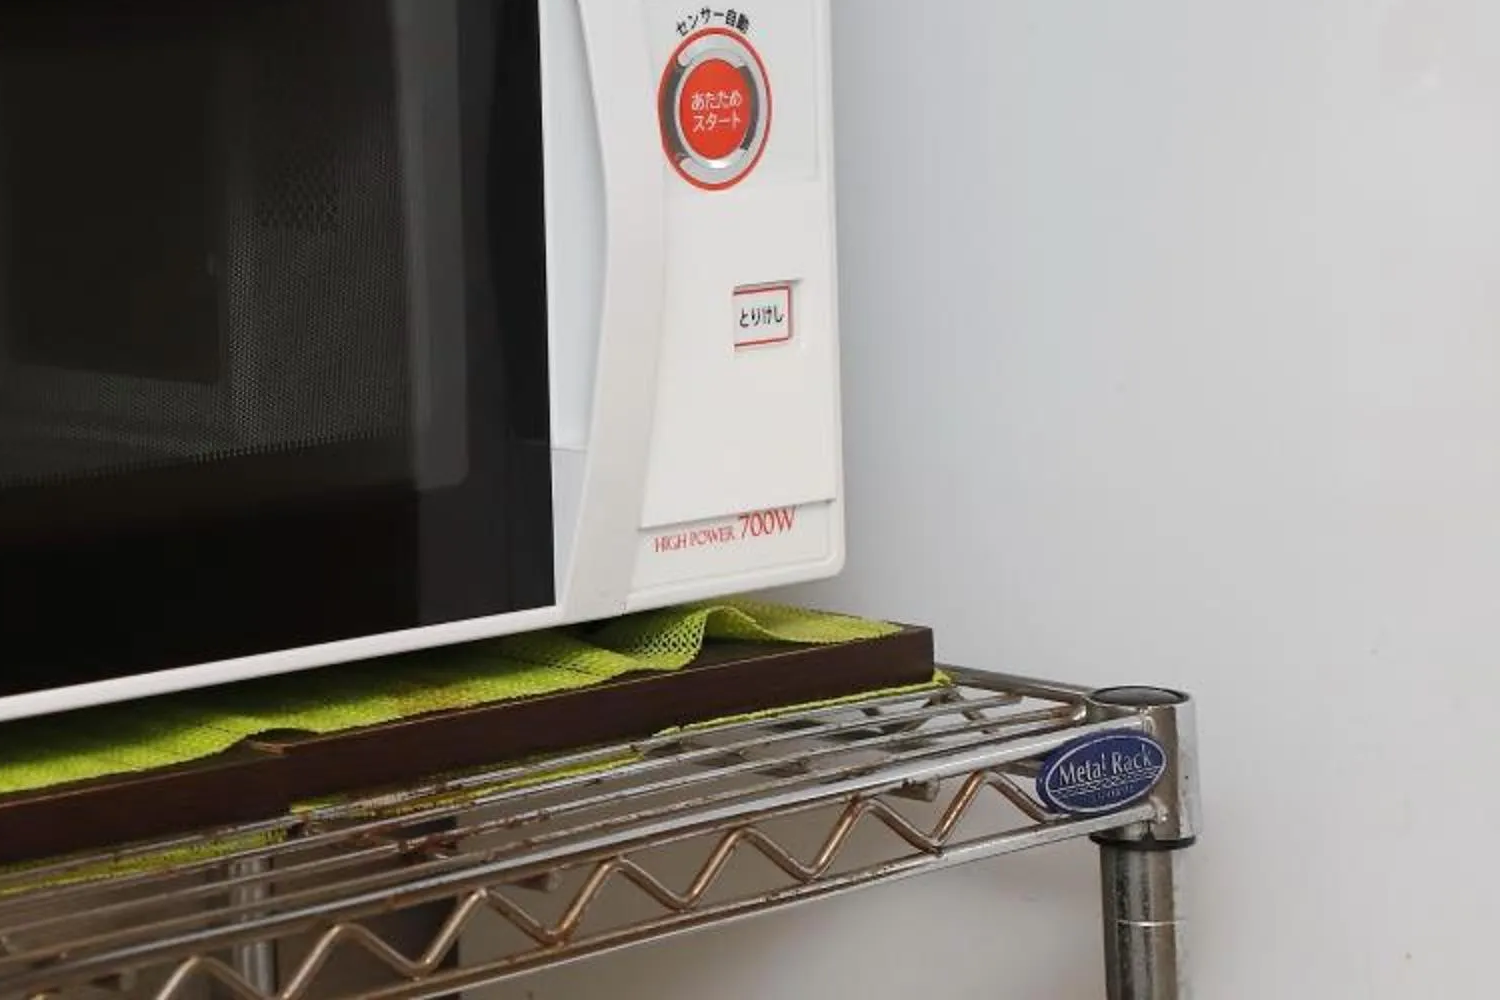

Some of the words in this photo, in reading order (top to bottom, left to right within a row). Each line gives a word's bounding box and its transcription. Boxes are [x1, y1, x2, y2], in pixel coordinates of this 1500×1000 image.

[676, 6, 750, 37] センサー自動
[691, 89, 742, 111] あたため
[693, 112, 741, 133] スタート
[739, 304, 785, 328] とりけし
[654, 533, 687, 552] HIGH
[689, 526, 735, 547] POWER
[738, 506, 796, 538] 700W
[1060, 752, 1107, 786] Metal
[1111, 743, 1152, 775] Rack
